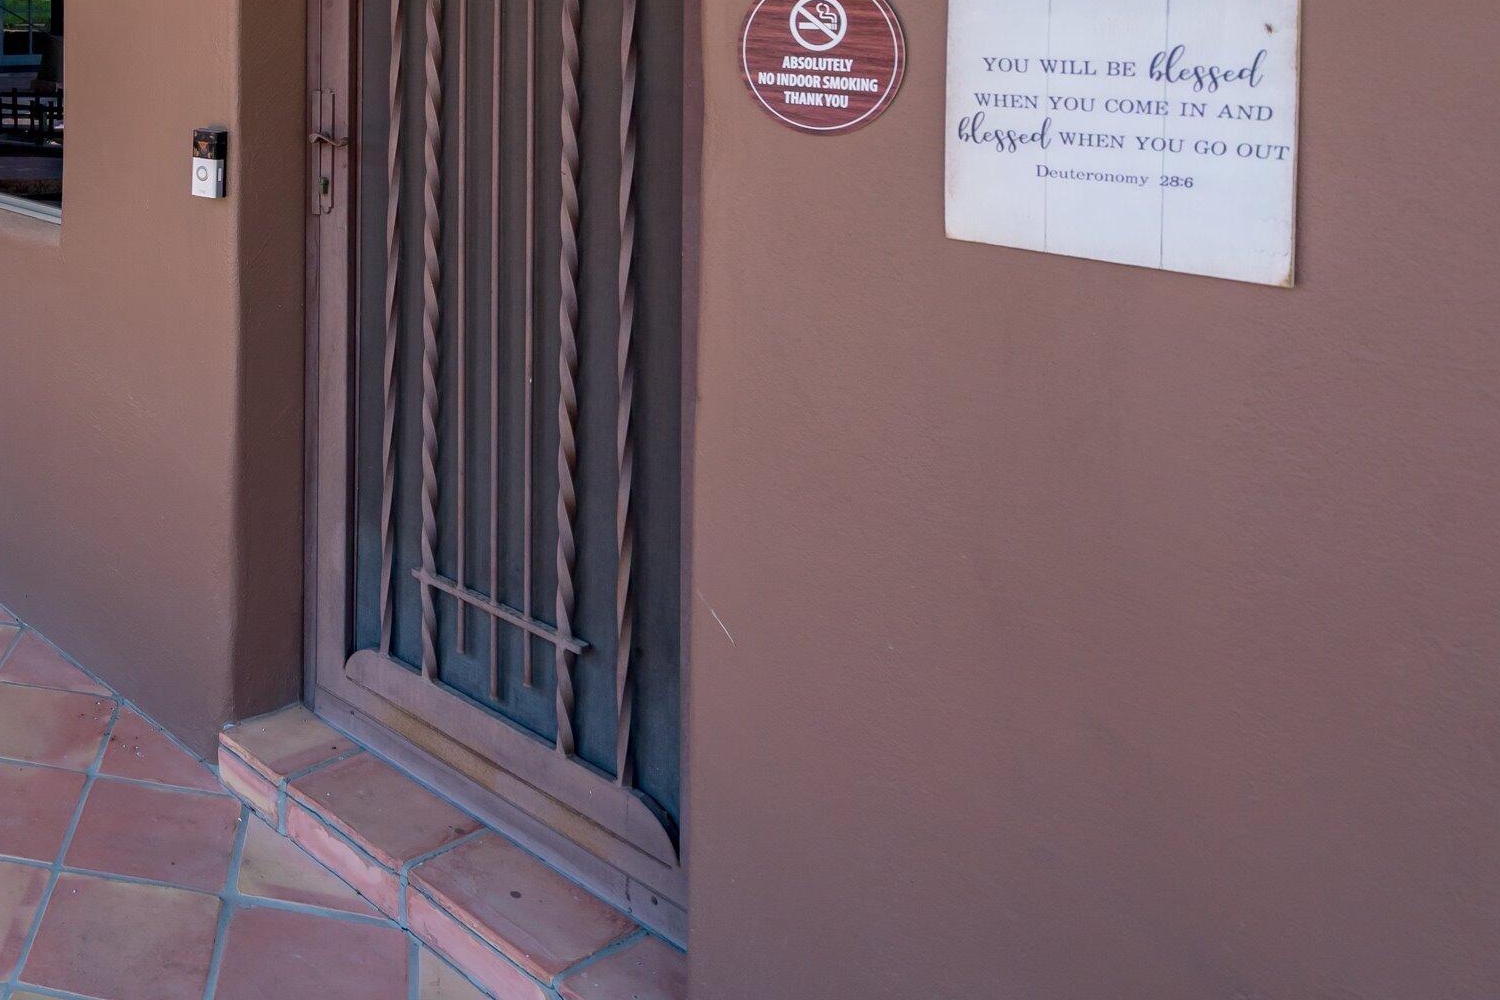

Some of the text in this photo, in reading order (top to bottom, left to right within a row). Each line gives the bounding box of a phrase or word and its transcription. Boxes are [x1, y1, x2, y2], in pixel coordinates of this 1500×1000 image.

[782, 56, 854, 72] ABSOLUTELY
[982, 44, 1268, 93] YOU WILL BE blessed
[758, 72, 879, 92] NO INDOOR SMOKING
[784, 91, 849, 109] THANK YOU
[973, 92, 1274, 122] WHEN YOU COME IN AND
[957, 111, 1291, 161] blessed WHEN YOU GO OUT
[1035, 164, 1194, 189] Deuteronomy 28:6
